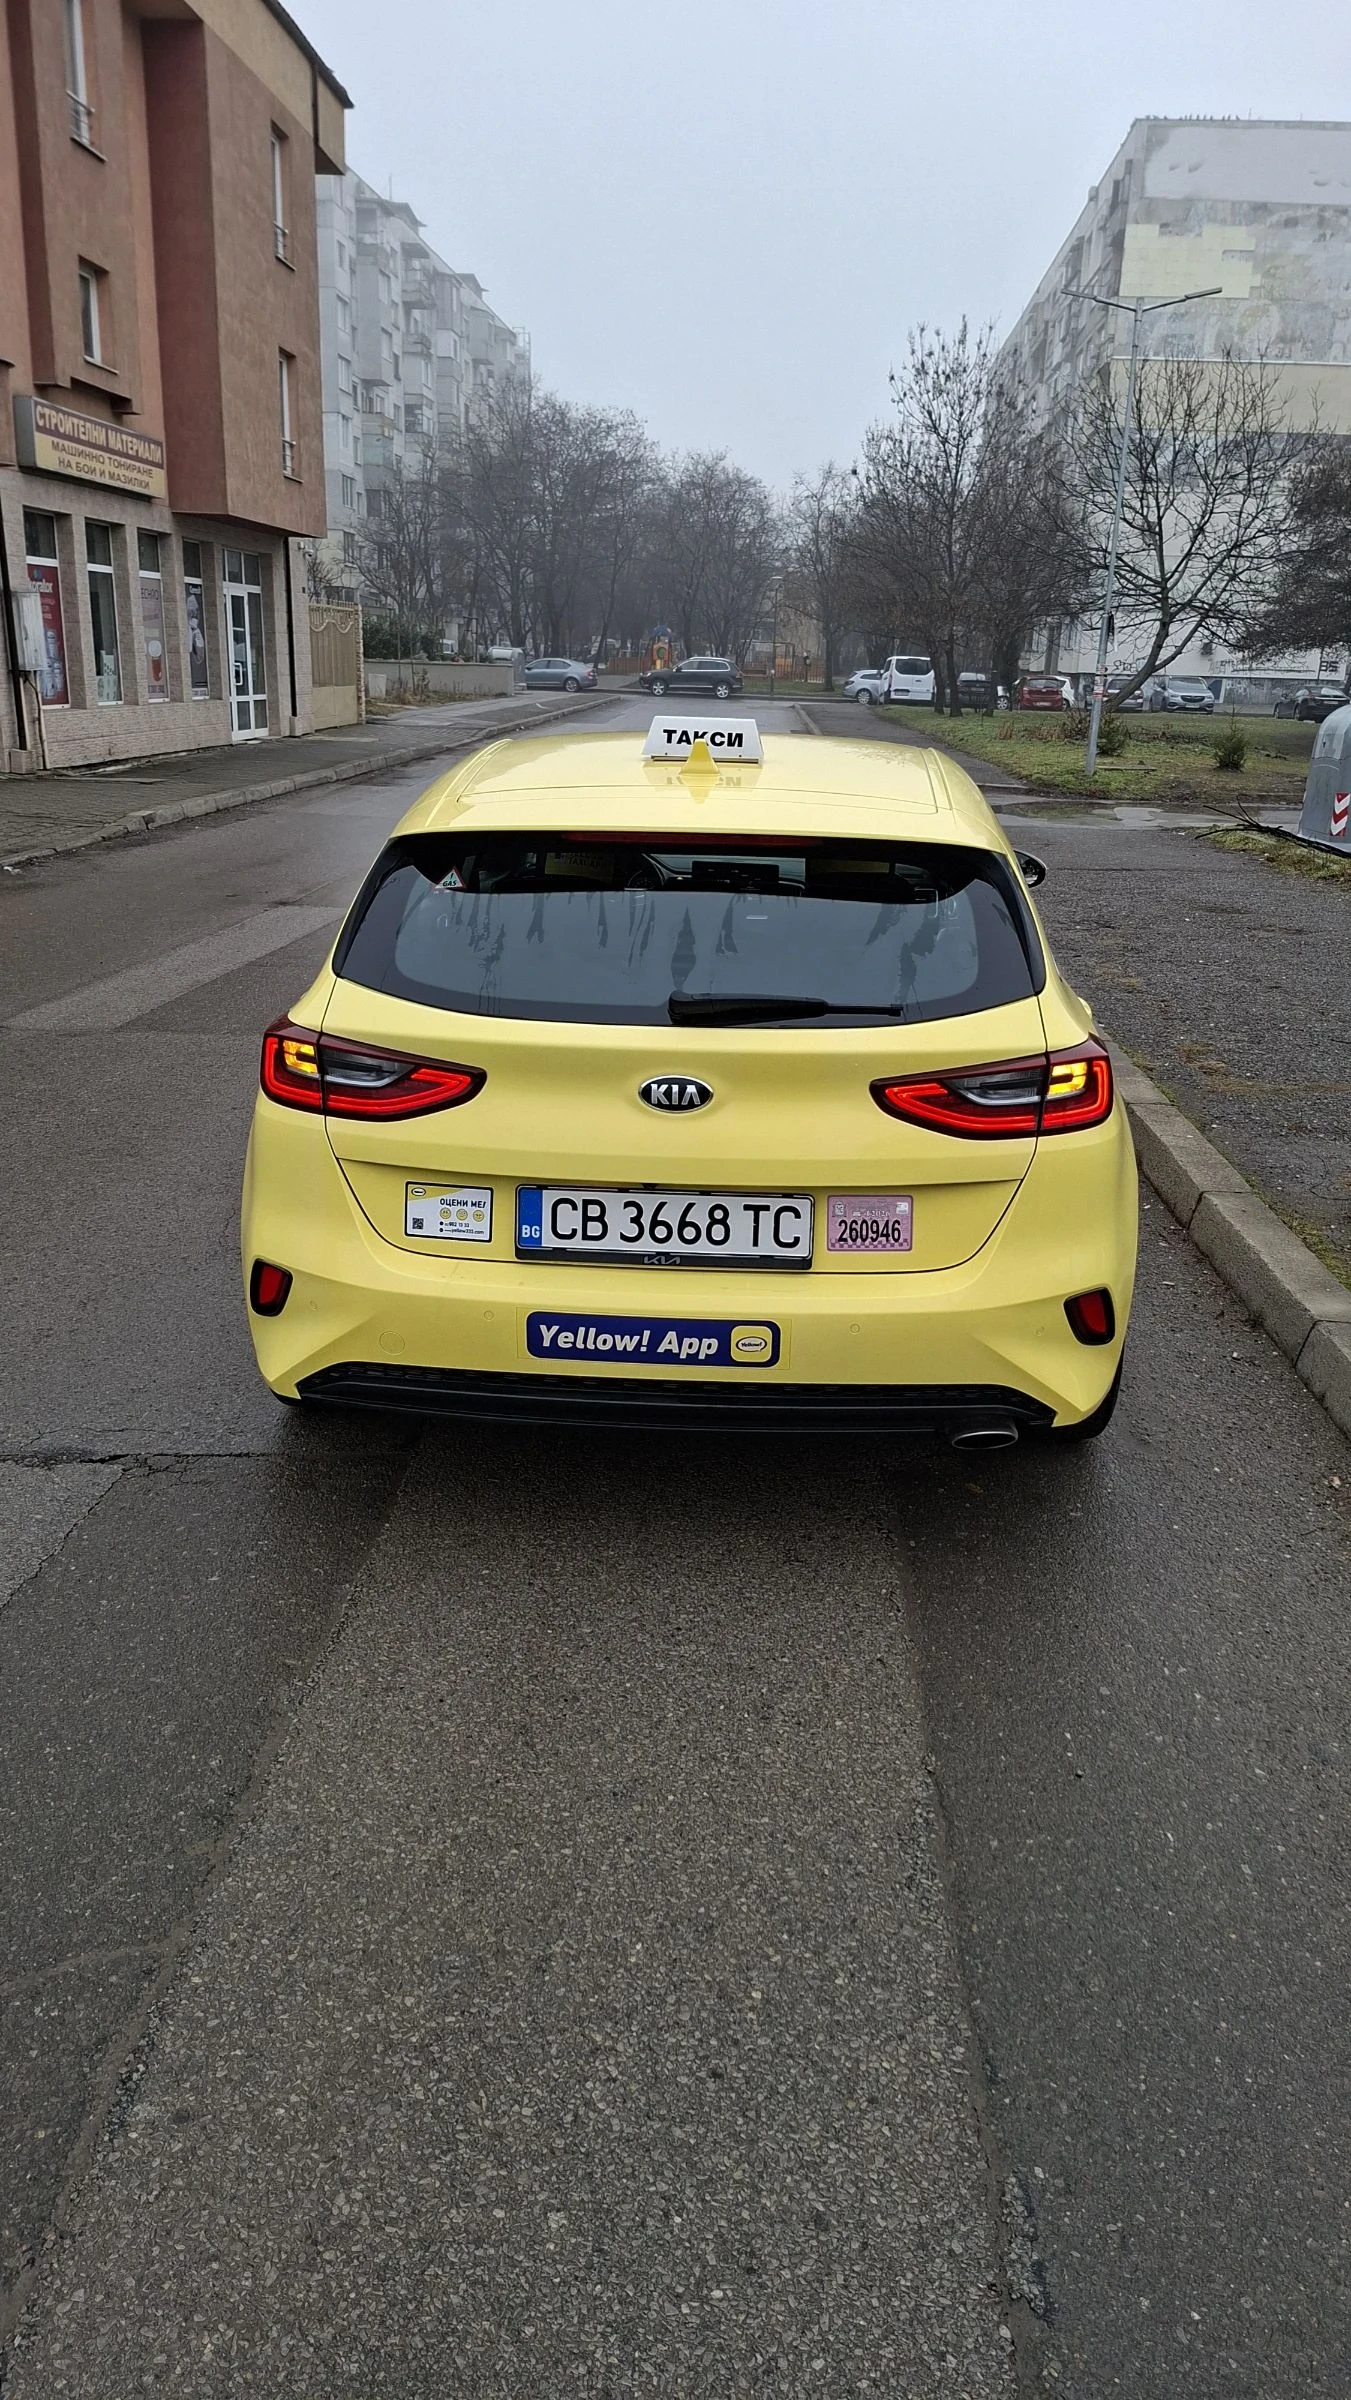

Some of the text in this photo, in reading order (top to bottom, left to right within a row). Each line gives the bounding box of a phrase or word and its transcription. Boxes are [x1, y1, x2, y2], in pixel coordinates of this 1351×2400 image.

[35, 405, 162, 463] СТРОИТЕЛНИ МАТЕРИАЛИ
[51, 440, 154, 479] МАШИННО ТОНИРАНЕ
[58, 457, 150, 490] НА БОИ И МАЗИЛКИ
[662, 728, 744, 748] ТАКСИ
[650, 1083, 701, 1105] KIA
[440, 1198, 486, 1208] ОЦЕНИ МЕ!
[521, 1224, 540, 1239] BG
[550, 1197, 802, 1249] CB 3668 TC
[837, 1219, 901, 1243] 260946
[538, 1324, 719, 1360] Yellow! App
